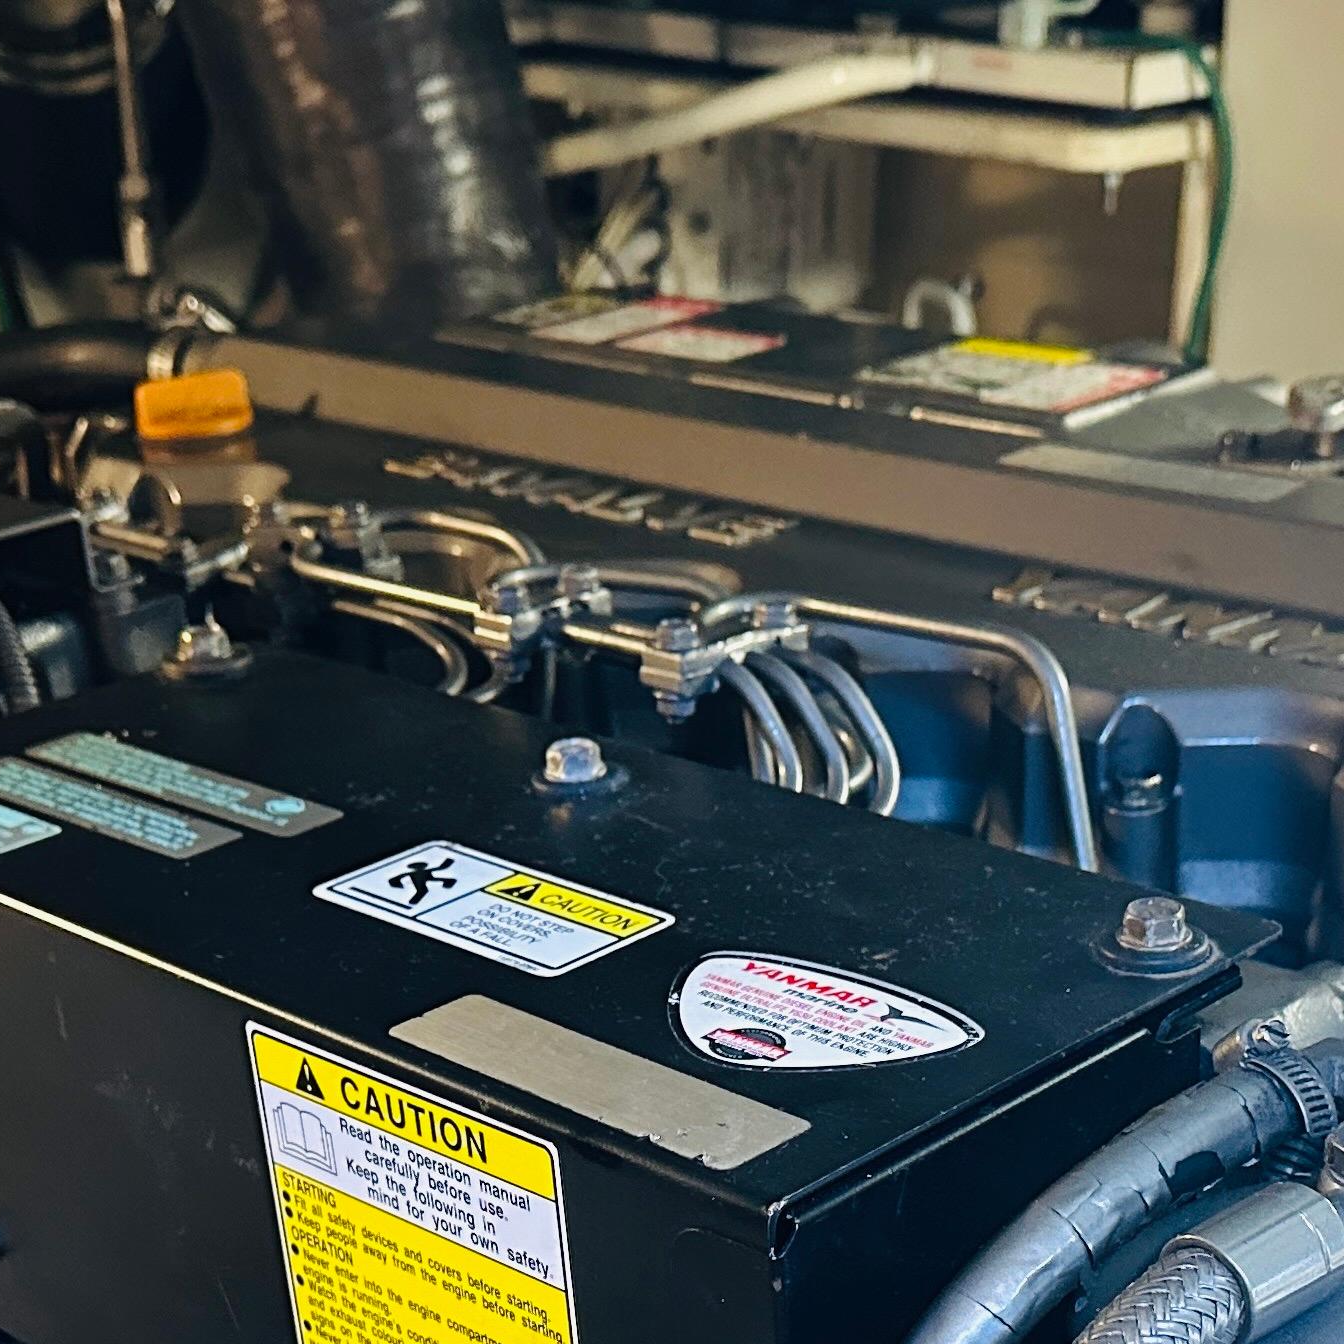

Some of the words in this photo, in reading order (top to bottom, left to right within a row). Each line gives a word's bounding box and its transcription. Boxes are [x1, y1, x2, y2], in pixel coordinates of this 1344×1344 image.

[539, 894, 640, 930] CAUTION
[742, 962, 878, 1007] YANMAR
[782, 988, 858, 1014] marine
[340, 1076, 487, 1163] CAUTION
[338, 1116, 372, 1144] Read
[378, 1134, 399, 1156] the
[407, 1149, 471, 1185] operation
[479, 1179, 530, 1211] manual
[364, 1149, 419, 1187] carefully
[427, 1172, 470, 1205] before
[478, 1198, 508, 1220] use.
[281, 1170, 336, 1208] STARTING
[346, 1157, 378, 1186] Keep
[385, 1174, 406, 1196] the
[412, 1186, 475, 1229] following
[482, 1215, 495, 1235] in
[290, 1224, 353, 1266] OPERATION
[293, 1193, 307, 1211] Fit
[311, 1204, 323, 1218] all
[327, 1211, 355, 1236] safety
[361, 1225, 398, 1253] devices
[403, 1246, 422, 1263] and
[427, 1257, 462, 1281] covers
[466, 1272, 501, 1299] before
[367, 1186, 399, 1211] mind
[406, 1200, 424, 1221] for
[431, 1214, 462, 1237] your
[470, 1232, 499, 1254] own
[506, 1247, 553, 1278] safety.
[296, 1210, 321, 1234] Keep
[325, 1225, 357, 1249] people
[362, 1242, 386, 1264] away
[391, 1254, 415, 1275] from
[419, 1267, 437, 1285] the
[441, 1279, 476, 1304] engine
[481, 1295, 515, 1321] before
[302, 1264, 334, 1287] engine
[338, 1280, 347, 1293] is
[302, 1247, 329, 1270] Never
[334, 1264, 358, 1283] enter
[363, 1277, 382, 1295] into
[386, 1287, 403, 1305] the
[407, 1299, 441, 1323] engine
[307, 1278, 337, 1302] Watch
[340, 1295, 356, 1312] the
[307, 1295, 325, 1308] and
[329, 1305, 366, 1331] exhaust
[310, 1310, 335, 1330] signs
[339, 1324, 352, 1338] on
